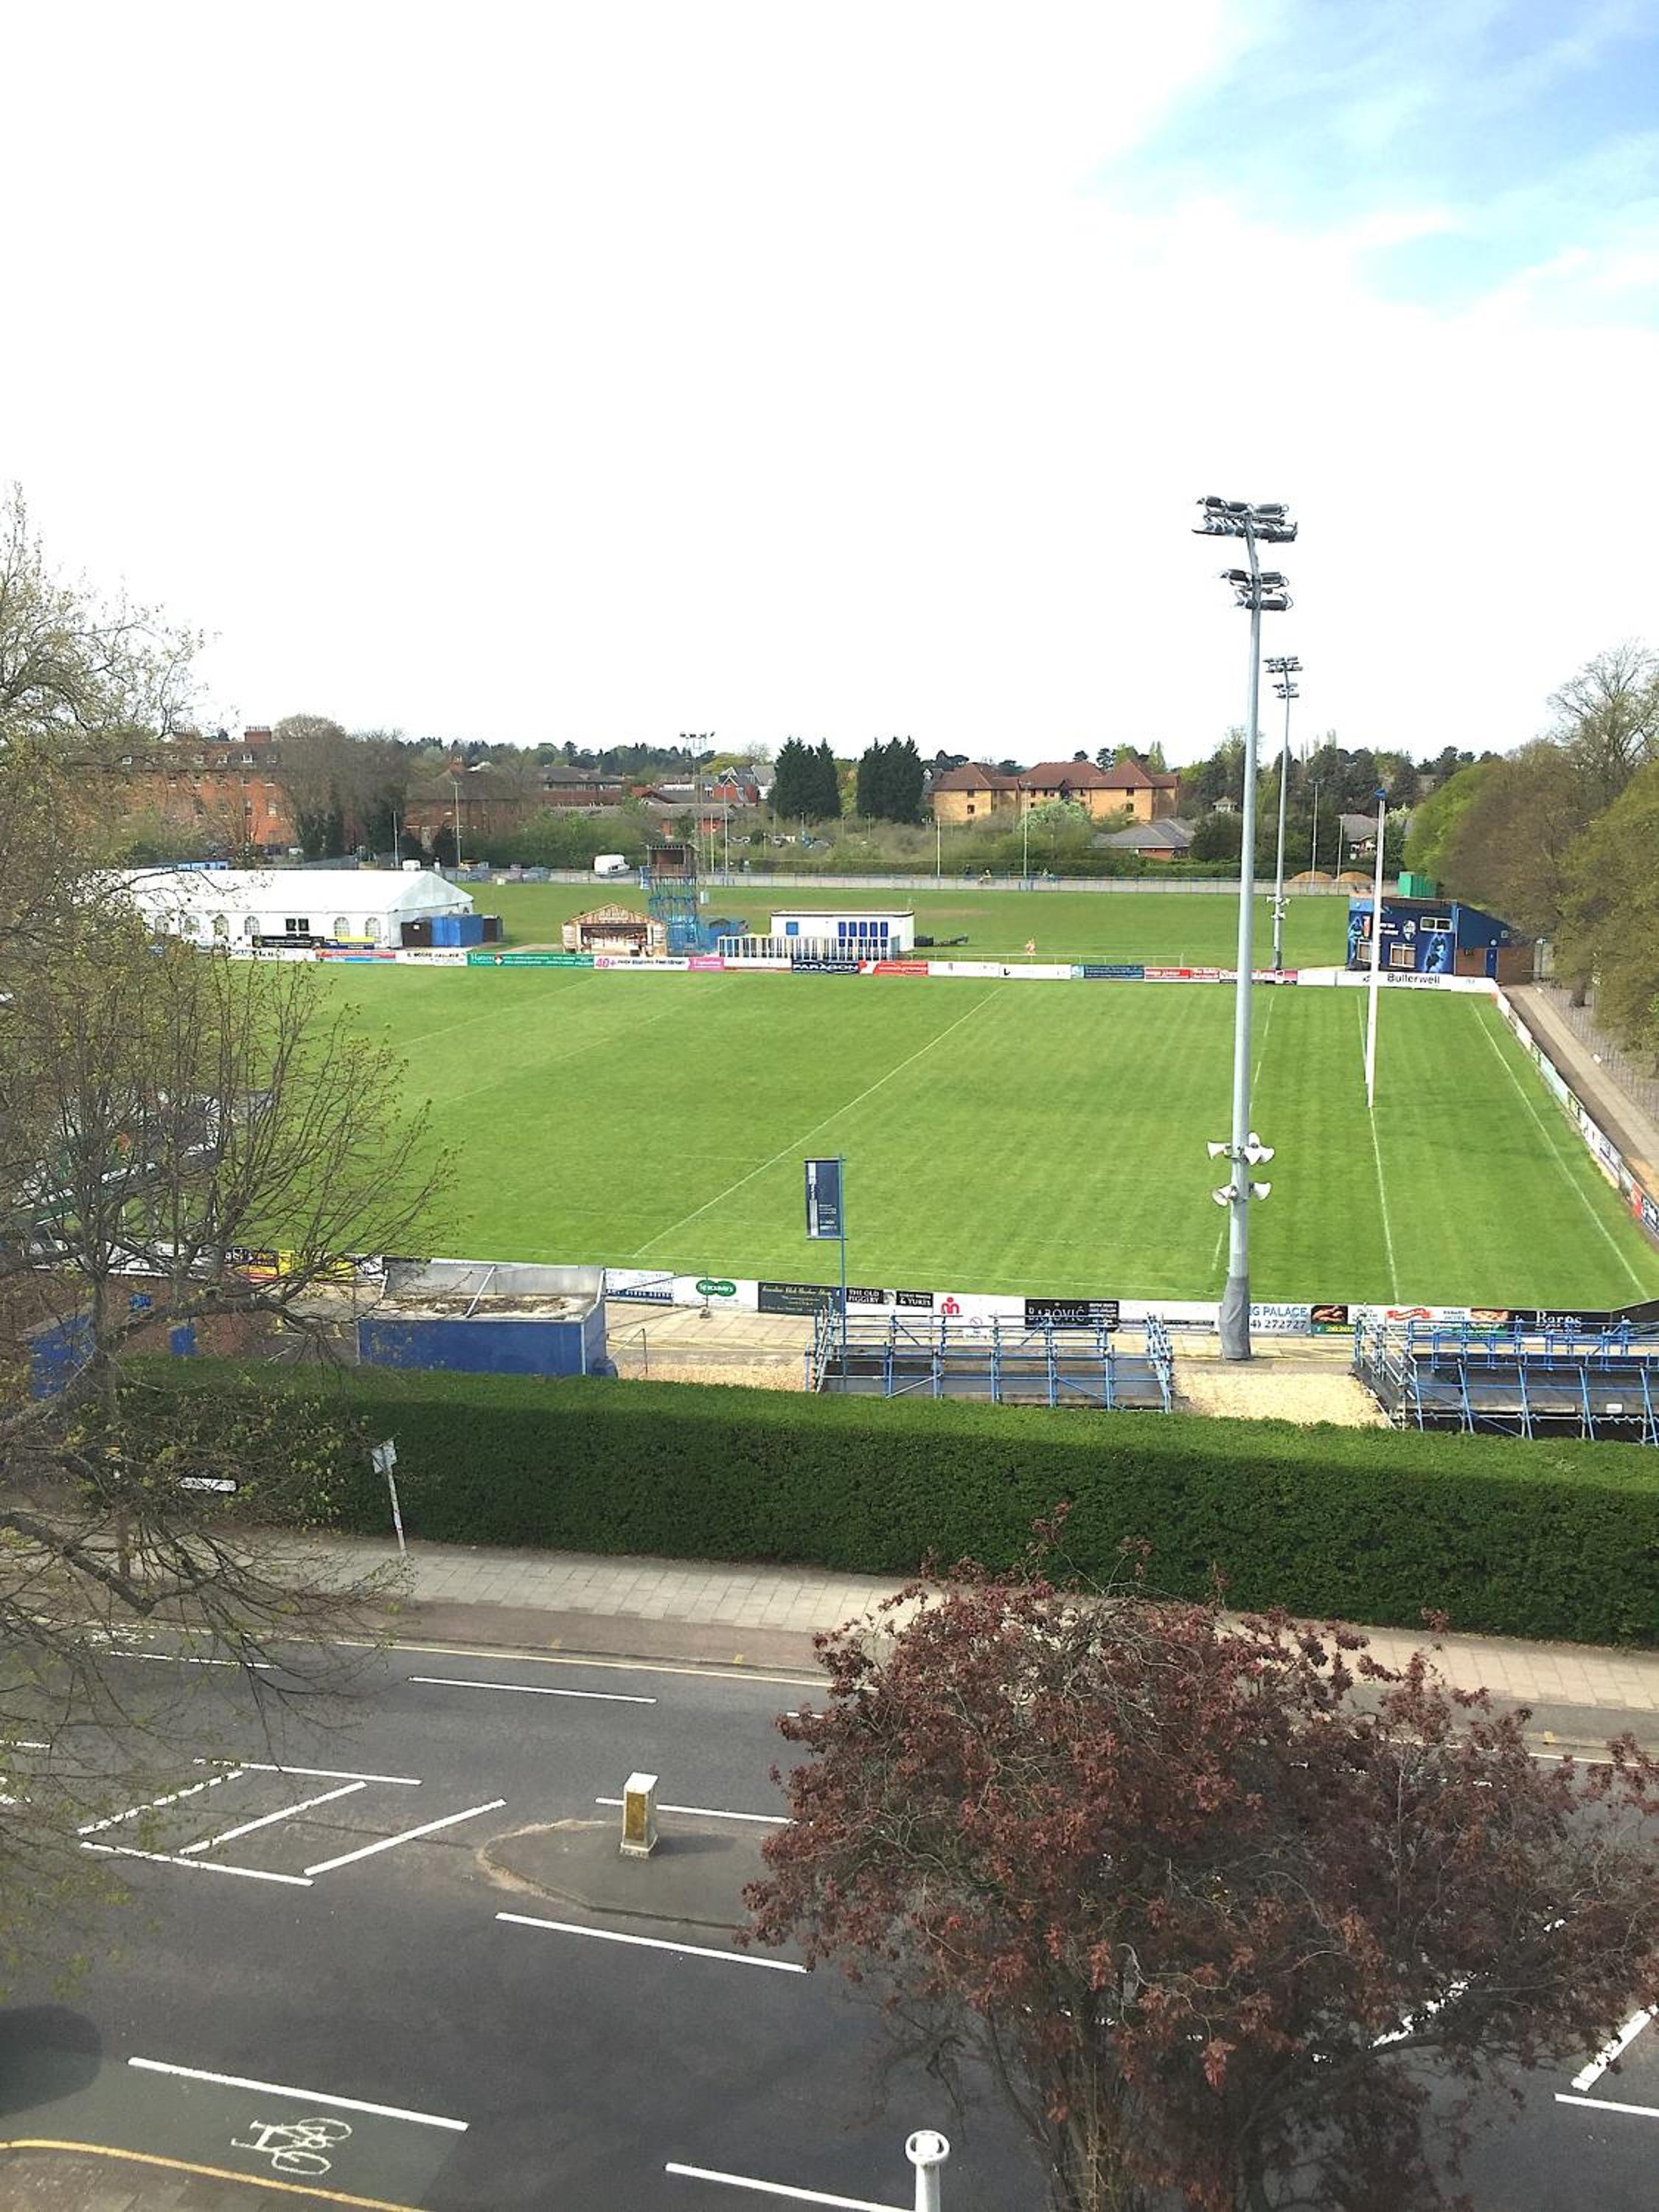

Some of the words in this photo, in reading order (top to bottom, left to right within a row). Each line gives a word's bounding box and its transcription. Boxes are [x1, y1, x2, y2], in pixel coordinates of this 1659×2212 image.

[792, 963, 858, 973] PARAGON
[1387, 973, 1440, 984] Bullerwell
[1263, 1306, 1307, 1318] PALACE
[1265, 1320, 1307, 1329] 272727
